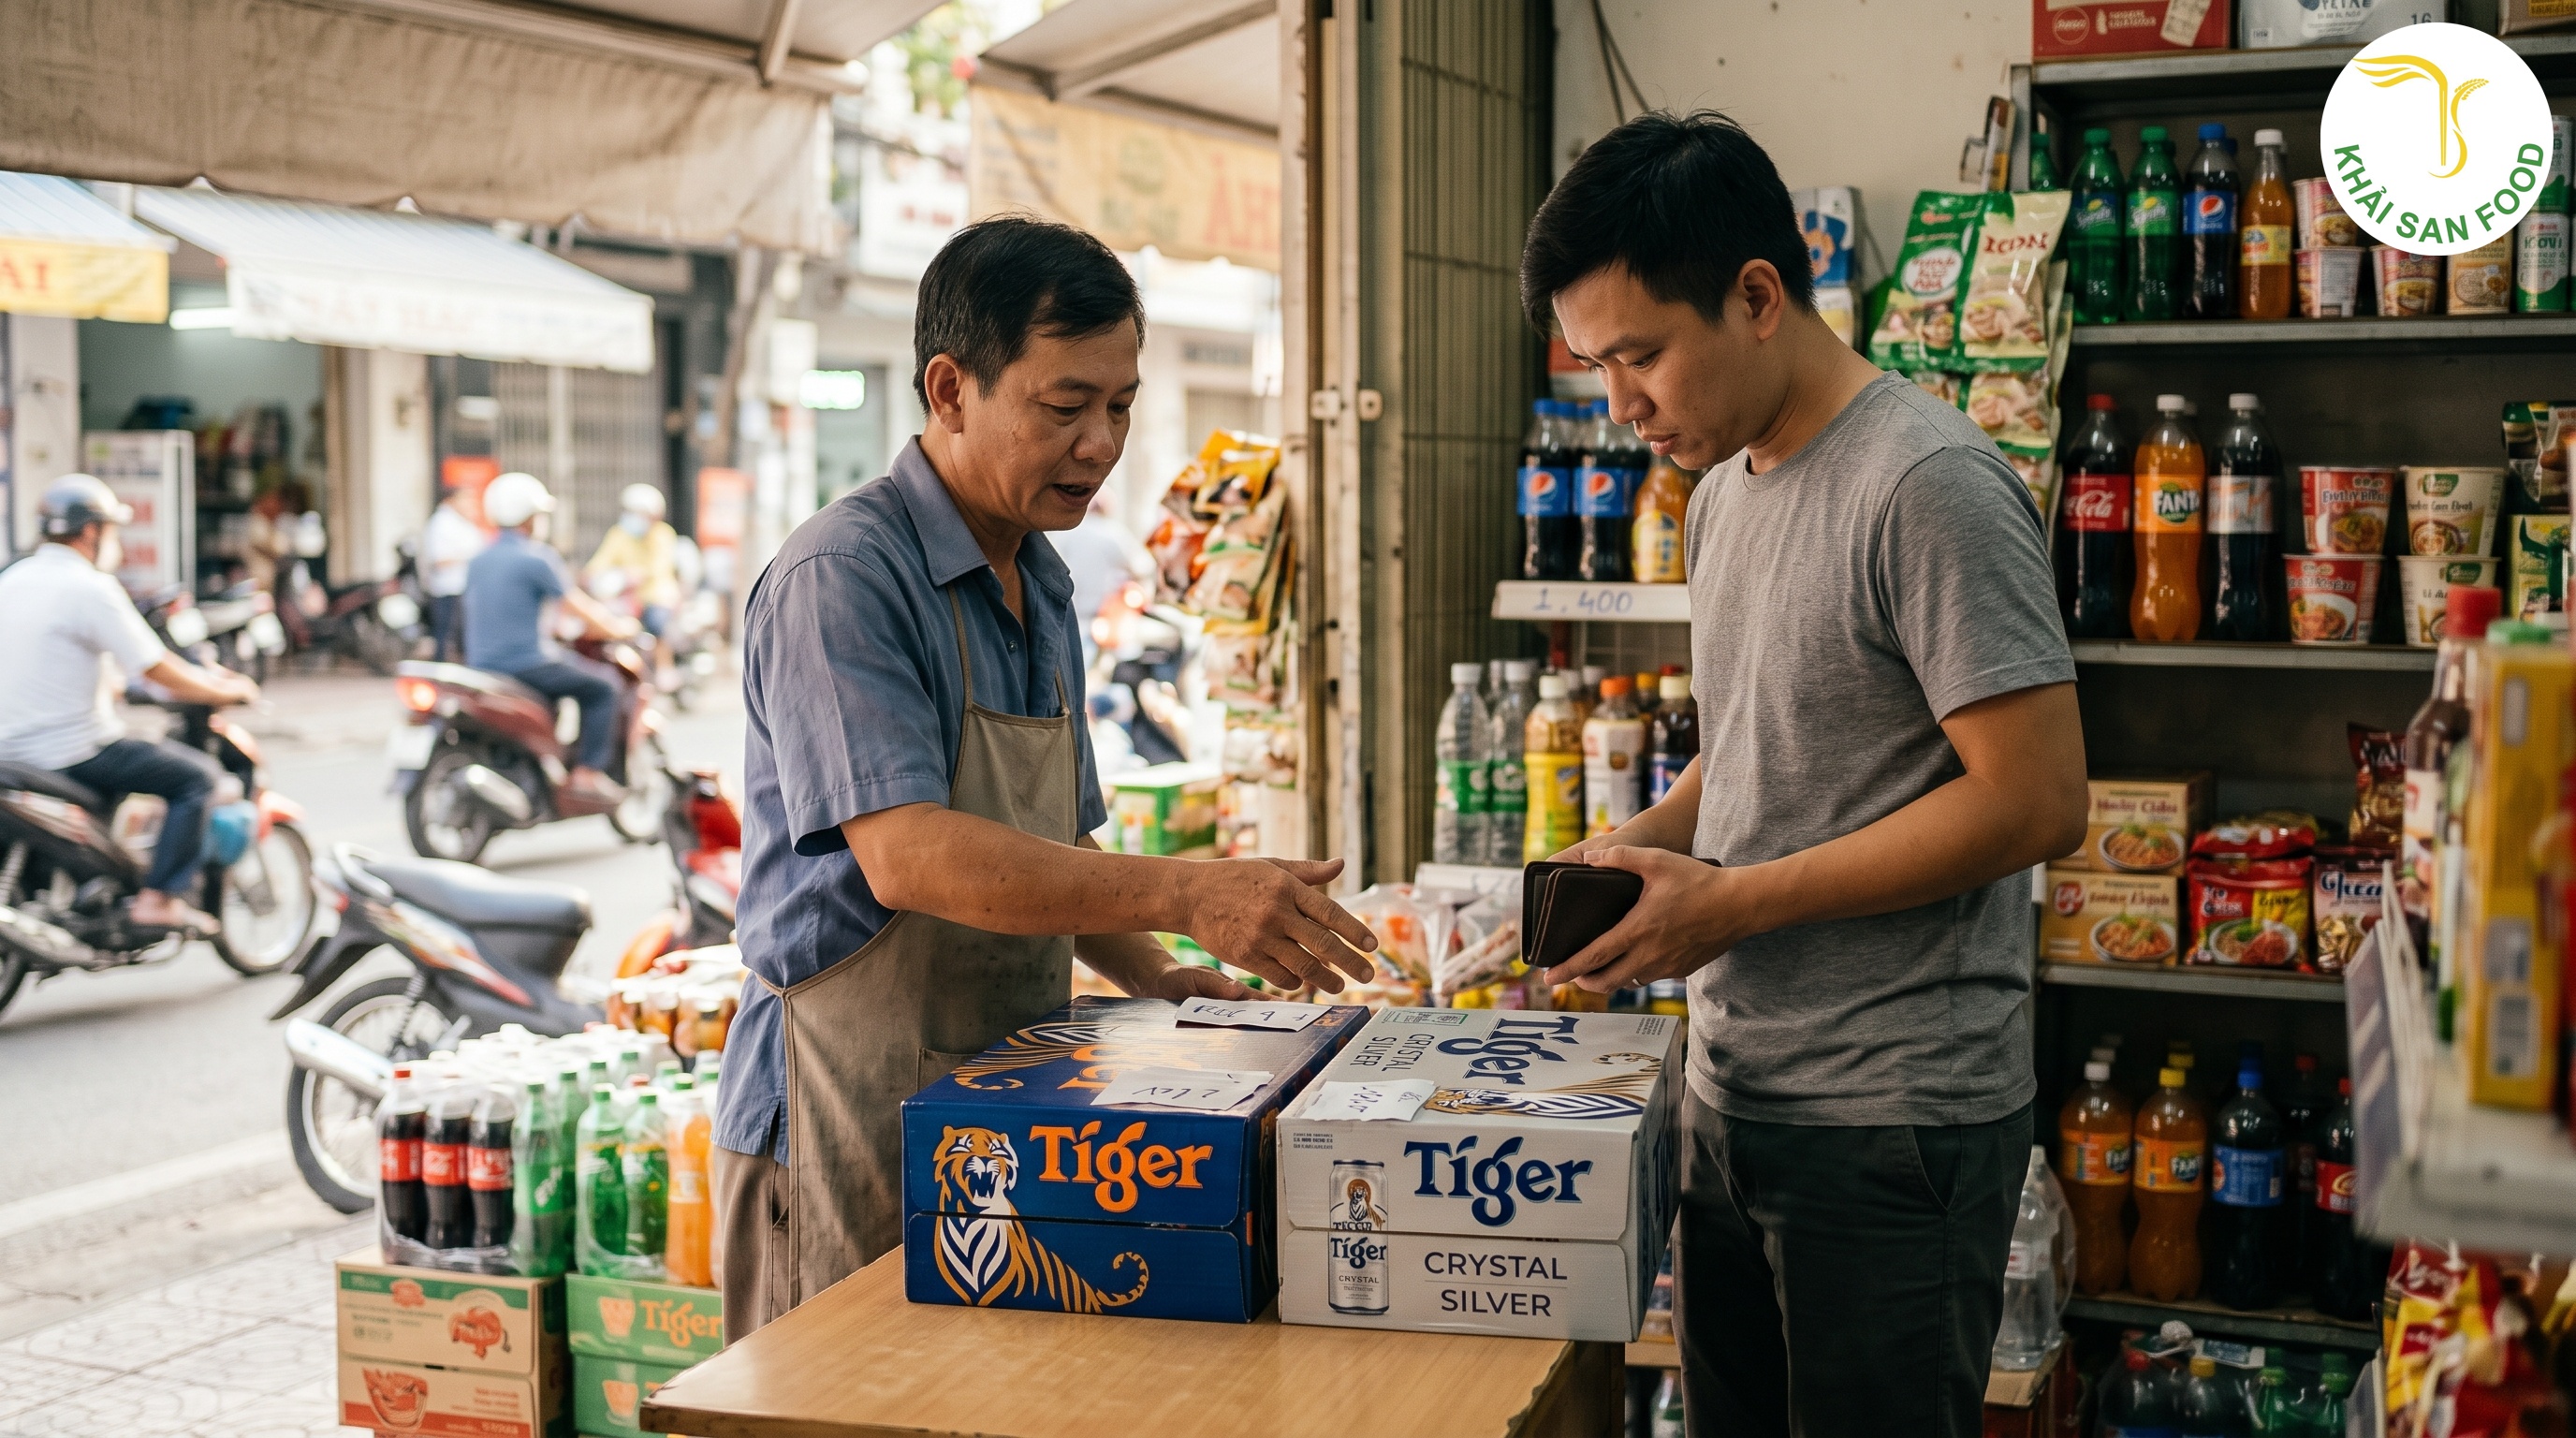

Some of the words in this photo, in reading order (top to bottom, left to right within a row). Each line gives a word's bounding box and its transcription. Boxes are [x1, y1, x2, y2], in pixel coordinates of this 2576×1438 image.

[1349, 1036, 1398, 1066] SILVER
[1381, 1033, 1436, 1072] CRYSTAL
[1435, 1015, 1580, 1085] Tiger
[1029, 1120, 1214, 1212] Tiger
[1404, 1135, 1594, 1227] Tiger
[1330, 1237, 1387, 1269] Tiger
[1424, 1251, 1568, 1281] CRYSTAL
[1339, 1274, 1380, 1284] CRYSTAL
[1440, 1288, 1551, 1317] SILVER
[639, 1299, 723, 1348] Tiger
